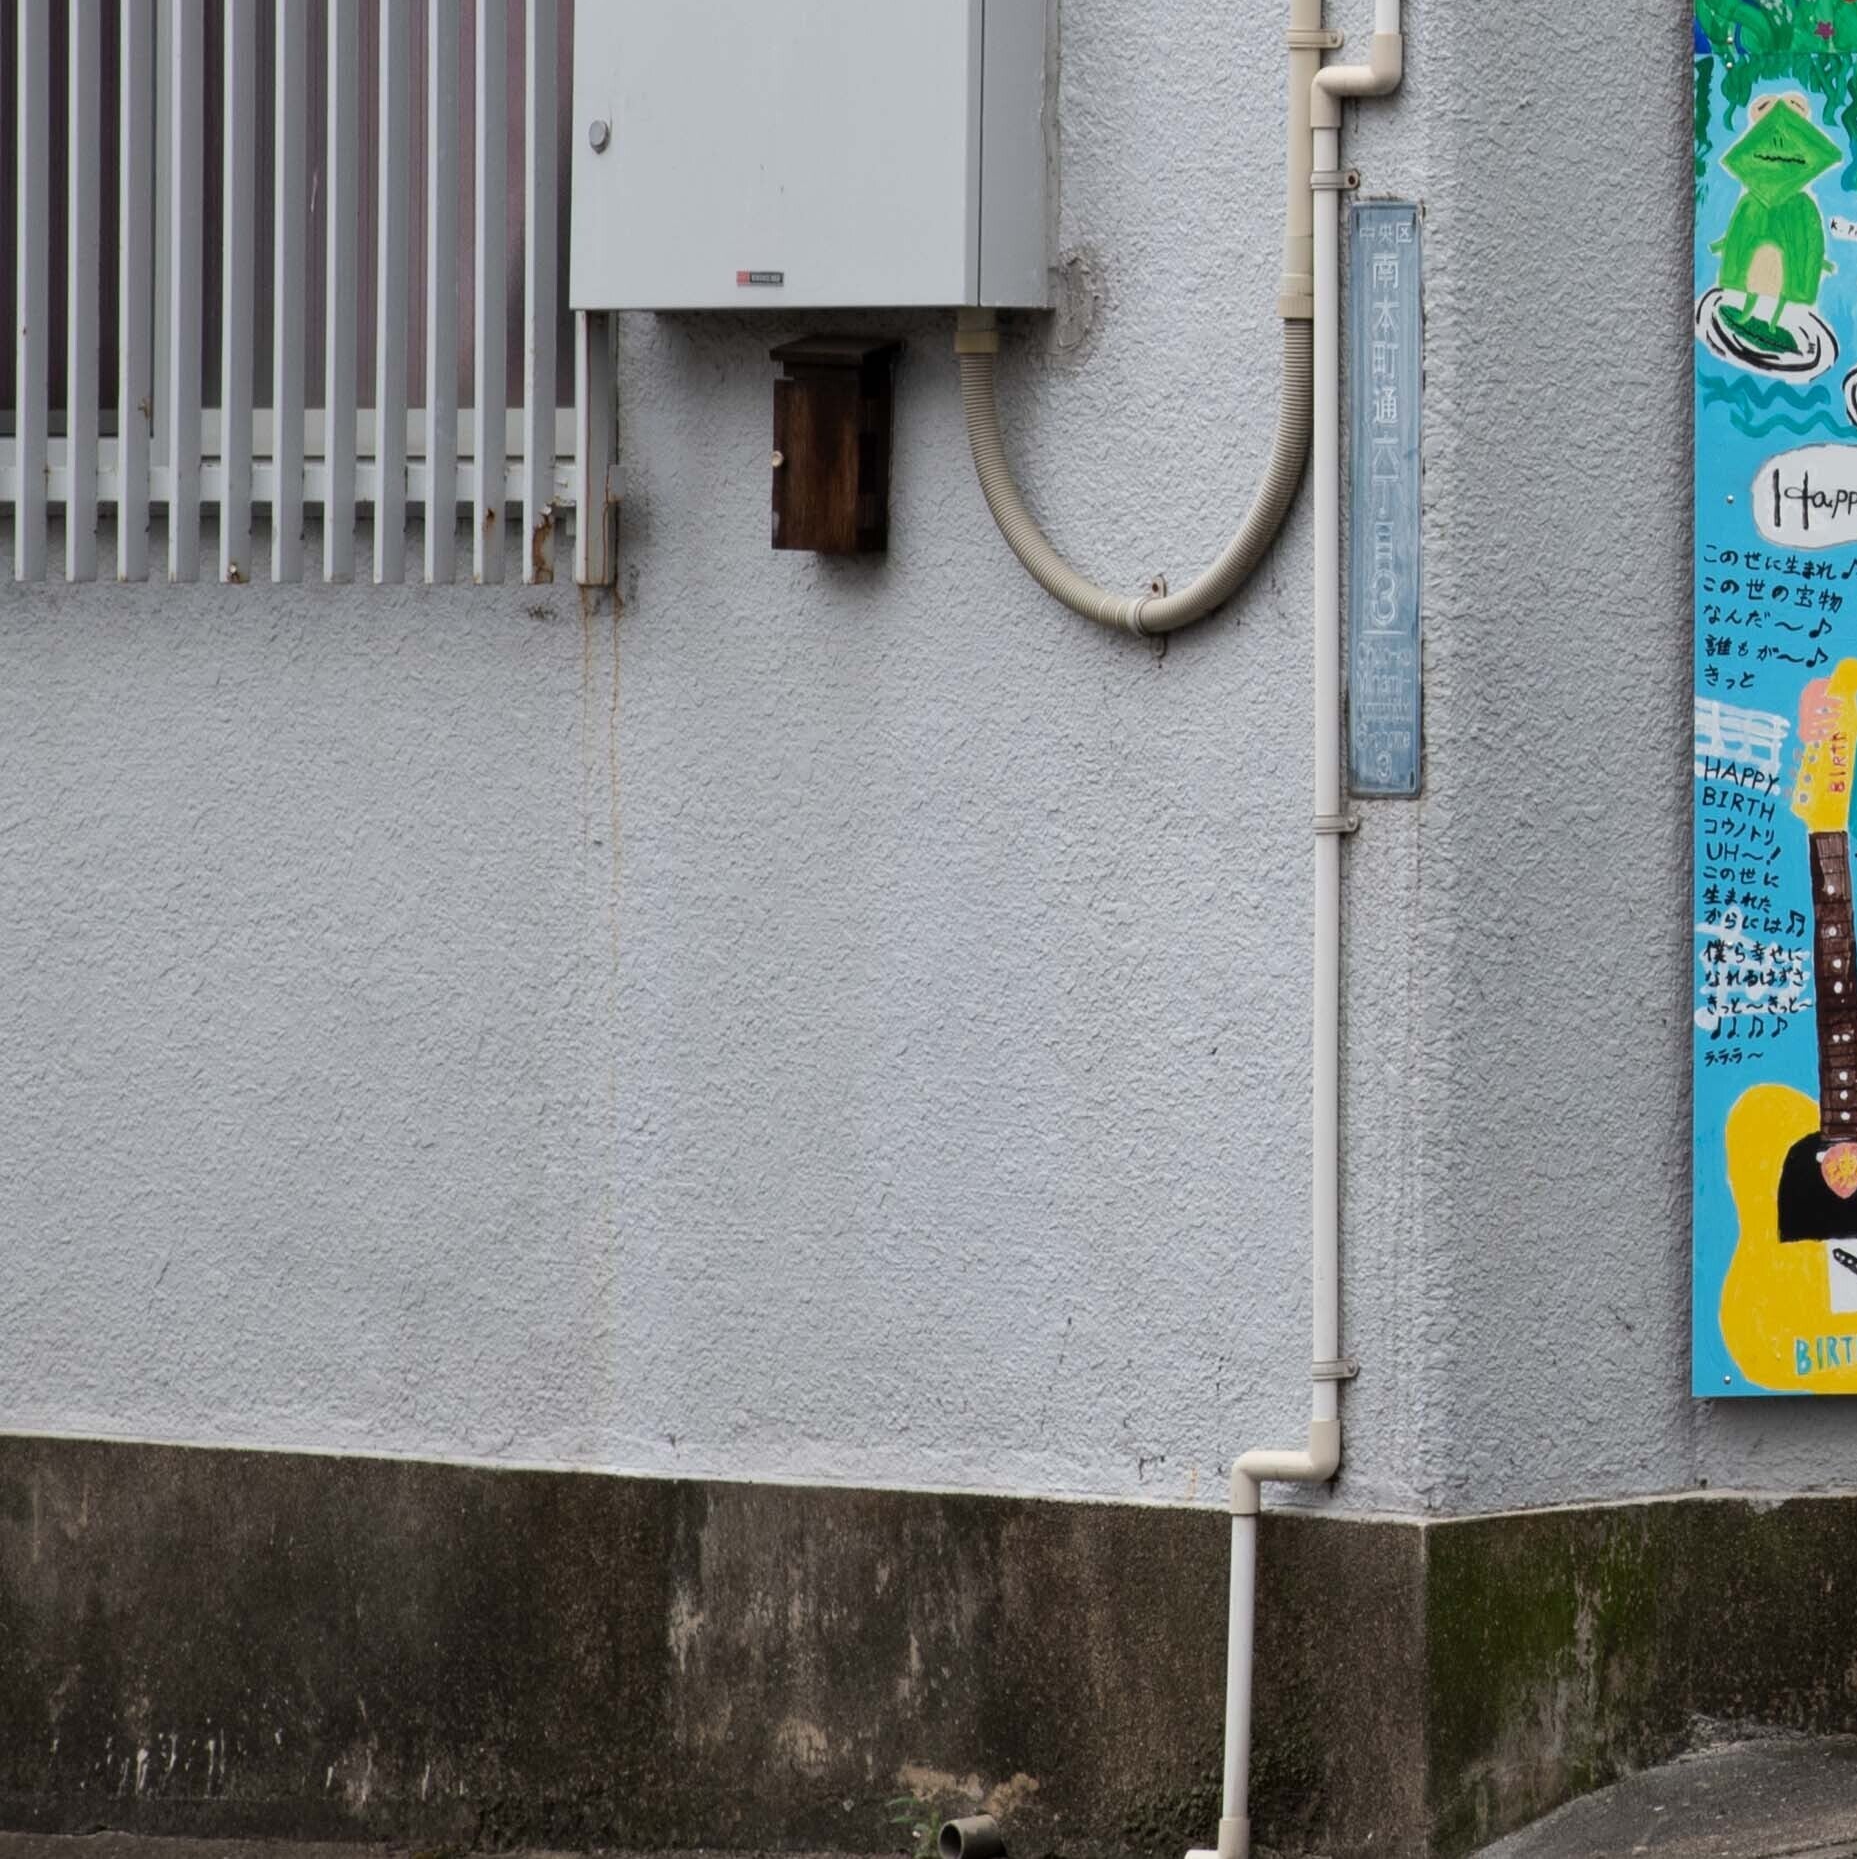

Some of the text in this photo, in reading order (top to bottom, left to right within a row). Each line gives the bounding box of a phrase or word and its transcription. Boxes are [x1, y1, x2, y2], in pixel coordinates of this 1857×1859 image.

[1359, 221, 1413, 244] 中央区
[1703, 544, 1838, 580] この世に生まれ
[1703, 577, 1844, 613] この世の宝物
[1704, 664, 1756, 690] きっと
[1703, 755, 1780, 797] HAPPY
[1702, 786, 1776, 822] BIRTH
[1704, 817, 1774, 846] コウノトリ
[1703, 866, 1780, 888] この世に
[1702, 884, 1773, 913] 生まれた
[1704, 907, 1783, 935] からには
[1704, 940, 1803, 966] 僕ら幸せに
